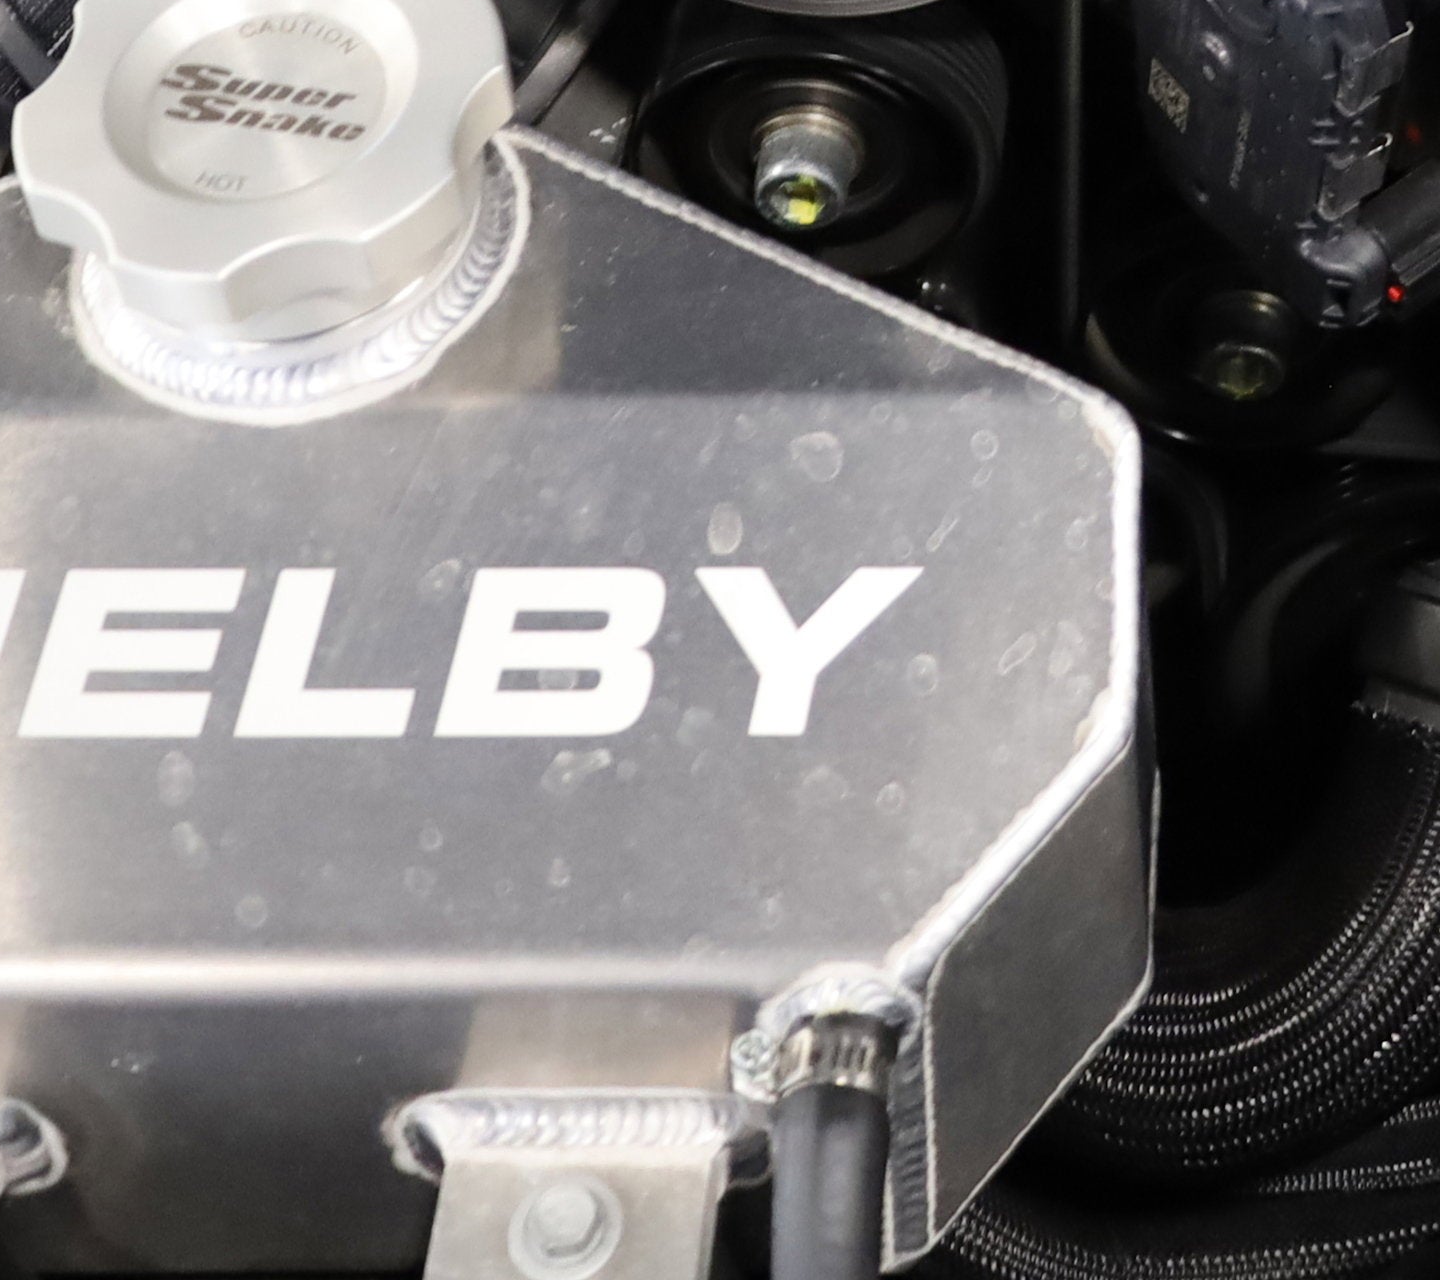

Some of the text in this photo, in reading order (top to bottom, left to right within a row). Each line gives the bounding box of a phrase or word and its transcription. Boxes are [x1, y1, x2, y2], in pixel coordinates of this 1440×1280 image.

[237, 16, 361, 56] CAUTION
[160, 63, 357, 110] Super
[164, 94, 367, 141] Snake
[194, 168, 249, 193] HOT
